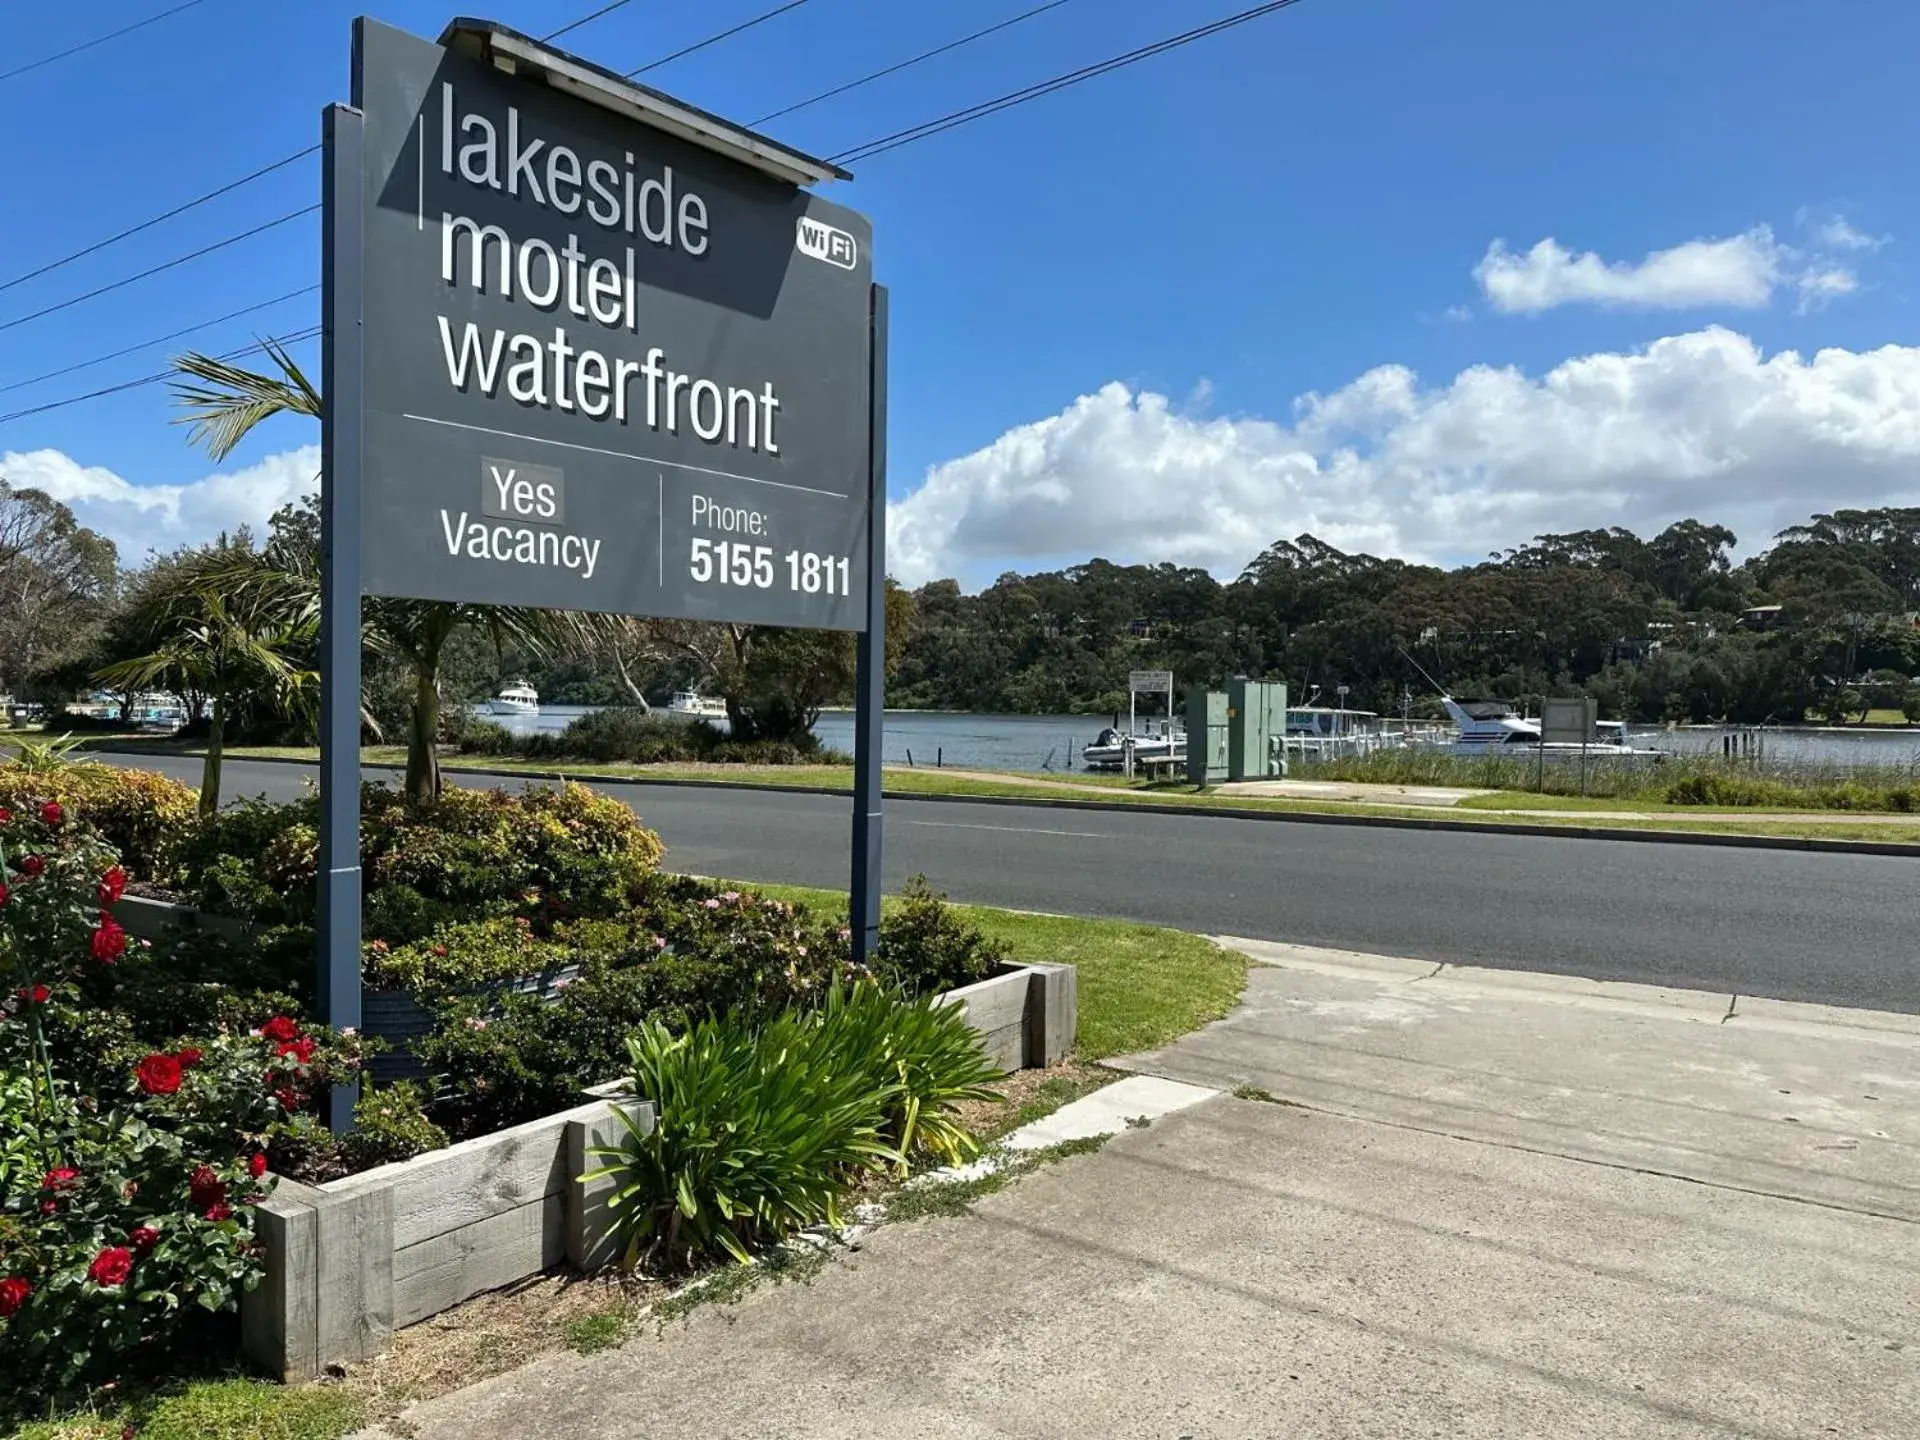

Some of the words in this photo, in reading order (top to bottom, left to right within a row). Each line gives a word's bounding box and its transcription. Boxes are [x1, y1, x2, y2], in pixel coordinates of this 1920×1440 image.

[440, 82, 708, 256] lakeside
[441, 211, 635, 328] motel
[438, 315, 779, 453] waterfront
[490, 466, 556, 517] Yes
[691, 495, 768, 536] Phone:
[440, 509, 601, 579] Vacancy
[690, 538, 774, 588] 5155
[785, 550, 850, 596] 1811
